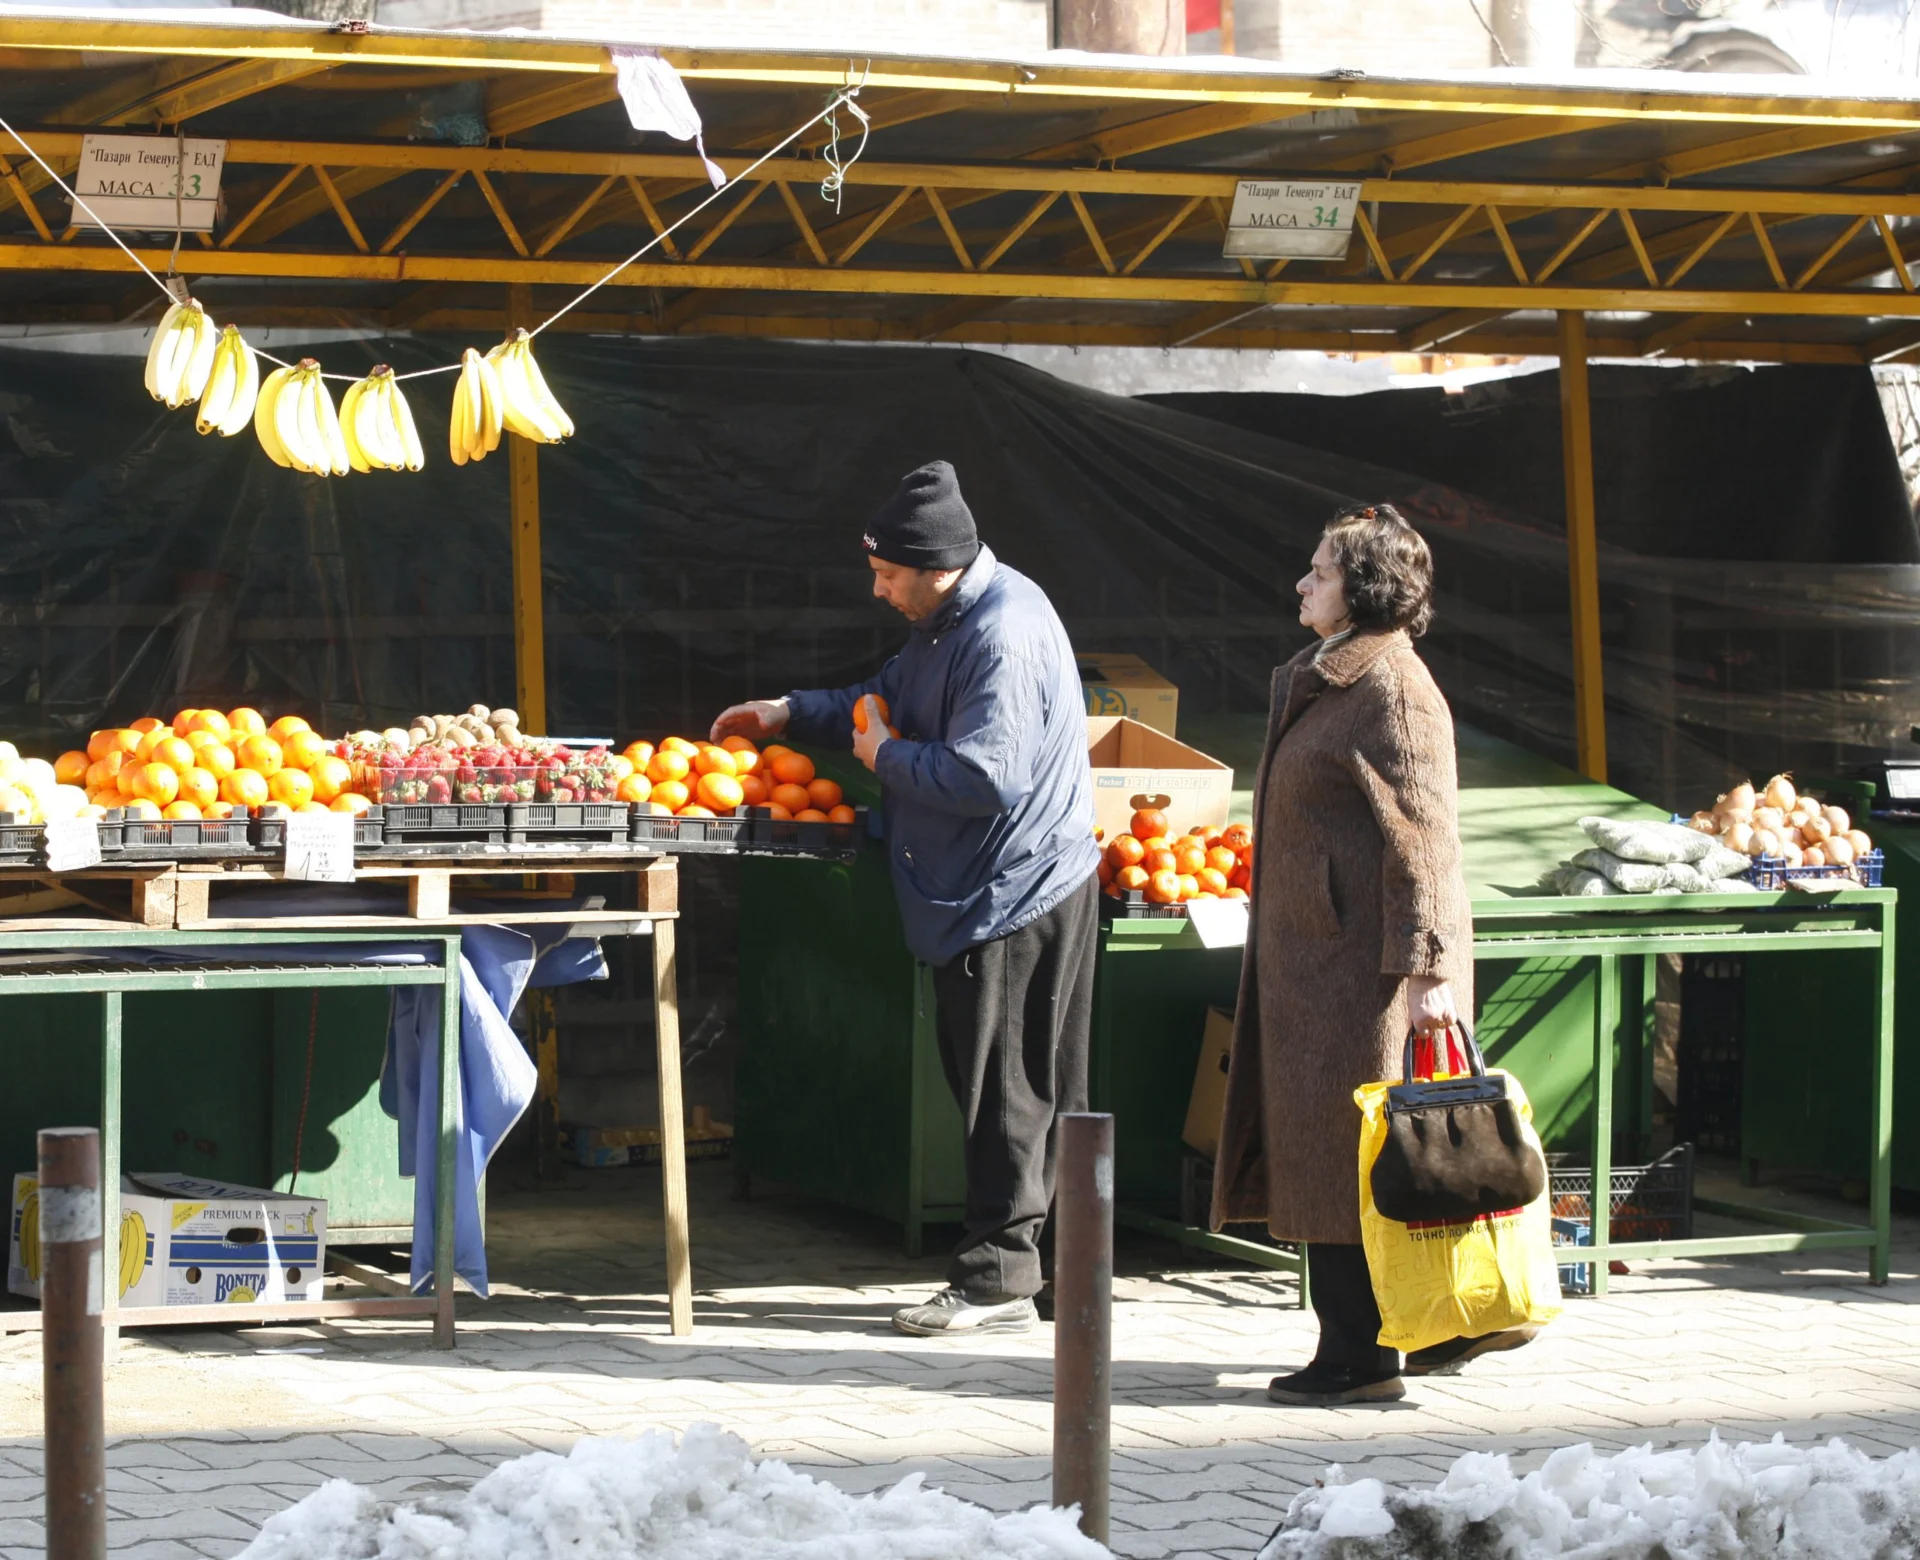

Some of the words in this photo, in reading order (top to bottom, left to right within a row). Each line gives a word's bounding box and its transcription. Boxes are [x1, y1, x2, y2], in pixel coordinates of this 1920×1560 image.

[193, 152, 217, 168] ЕАД
[97, 180, 156, 196] МАСА
[168, 173, 202, 198] 33
[1333, 186, 1357, 200] ЕАД
[1248, 212, 1298, 228] МАСА
[1308, 205, 1339, 228] 34
[203, 1209, 252, 1220] PREMIUM
[1409, 1230, 1445, 1242] ТОЧНО
[1449, 1227, 1462, 1238] ПО
[1467, 1222, 1491, 1235] МОЯ
[1494, 1218, 1521, 1231] ВКУС
[214, 1273, 267, 1303] BONITA
